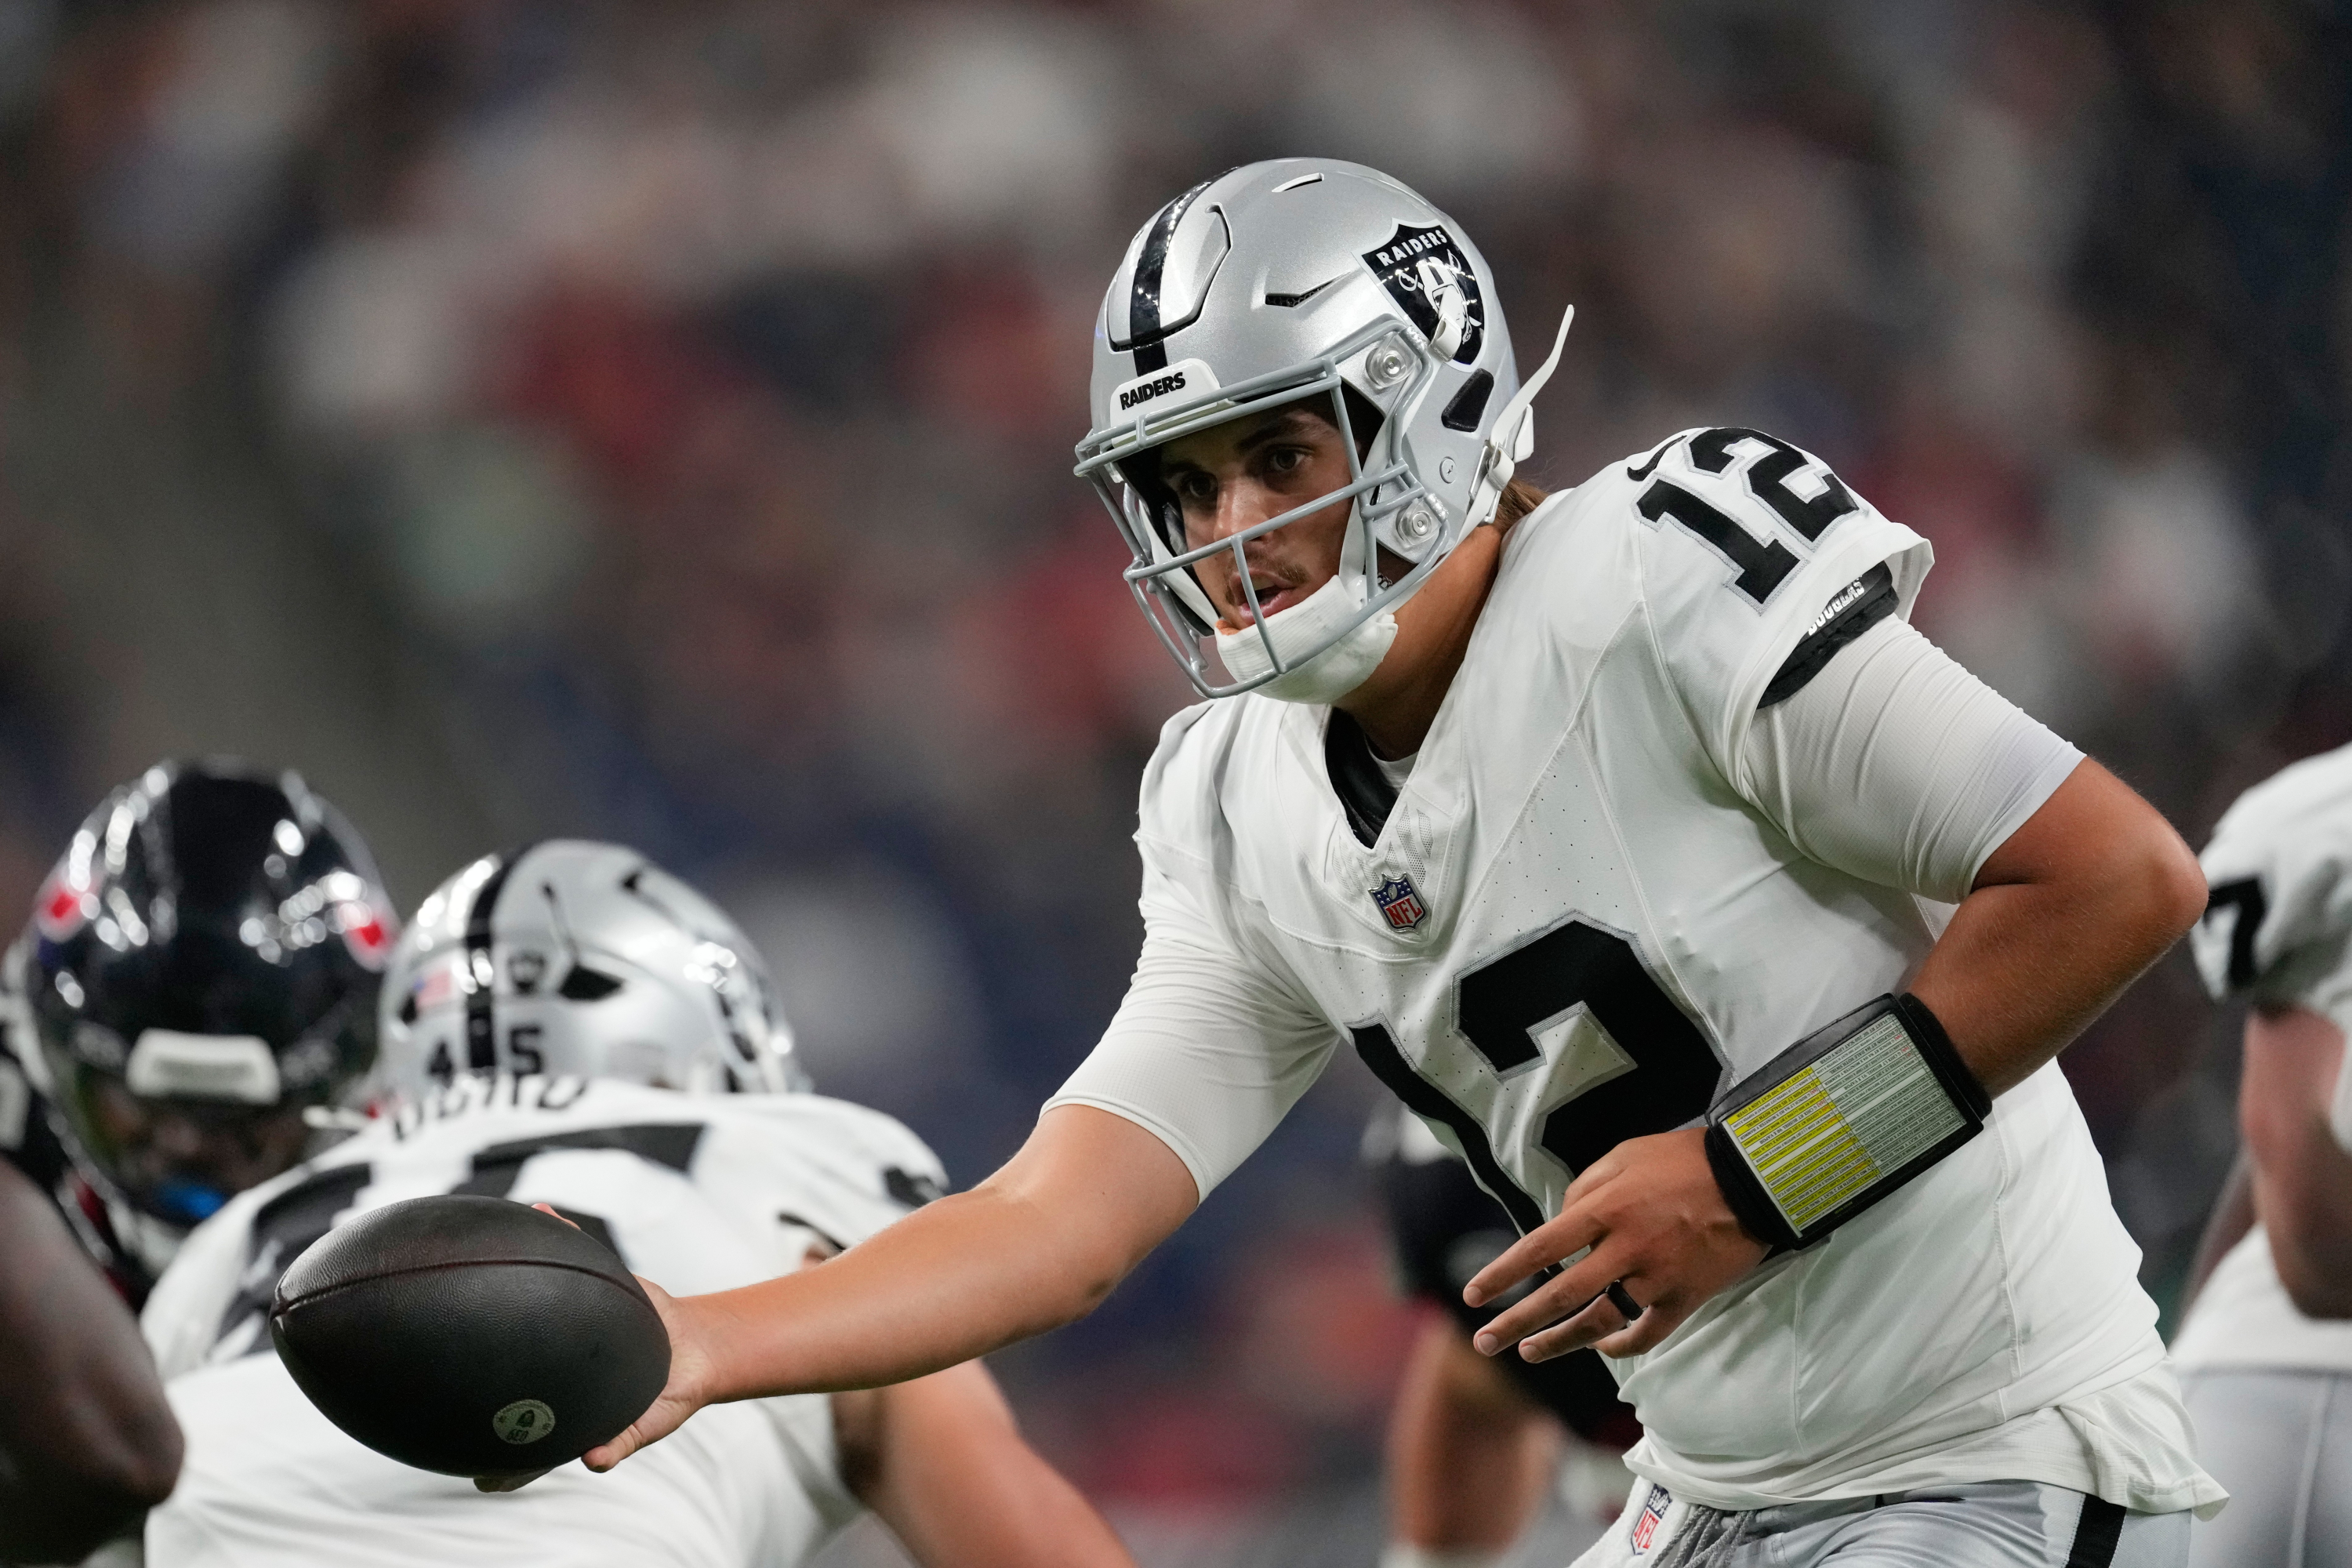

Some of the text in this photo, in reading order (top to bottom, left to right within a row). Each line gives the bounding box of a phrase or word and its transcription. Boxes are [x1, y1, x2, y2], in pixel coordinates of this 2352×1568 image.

[1376, 230, 1448, 267] RAIDERS
[1120, 372, 1186, 410] RAIDERS
[1632, 427, 1867, 614] 12
[1385, 897, 1423, 926] NFL
[1344, 909, 1733, 1262] 12
[1634, 1510, 1660, 1550] NFL
